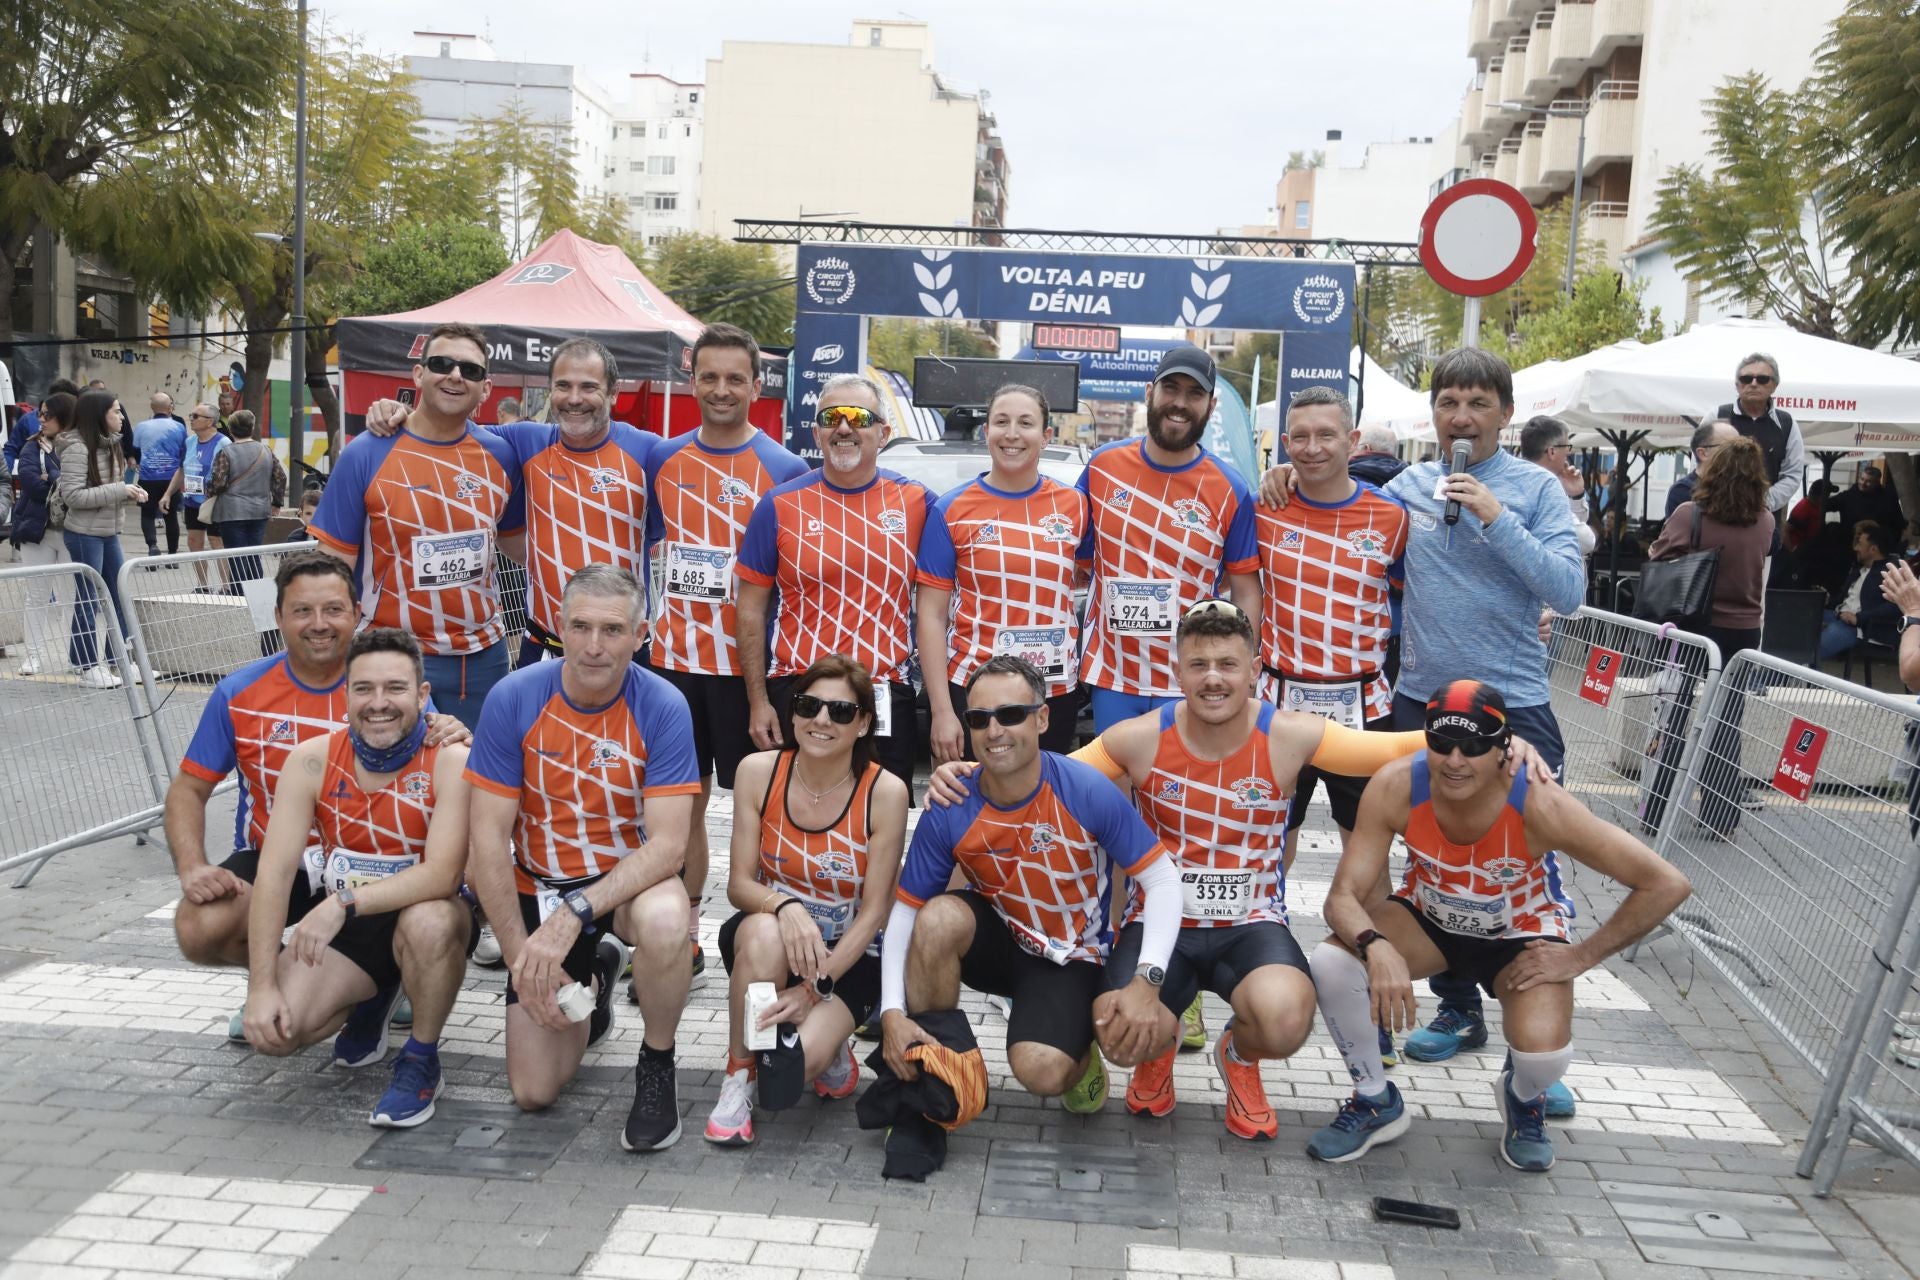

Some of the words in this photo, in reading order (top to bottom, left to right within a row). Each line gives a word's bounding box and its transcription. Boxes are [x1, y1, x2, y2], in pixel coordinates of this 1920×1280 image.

[1001, 266, 1073, 286] VOLTA
[1076, 270, 1094, 287] A
[1098, 271, 1145, 289] PEU
[1029, 288, 1112, 315] DÉNIA
[1291, 368, 1343, 379] BALEARIA
[1818, 399, 1857, 411] DAMM
[424, 563, 432, 574] C
[441, 558, 466, 573] 462
[437, 572, 471, 583] BALEARIA
[672, 569, 678, 580] B
[684, 570, 705, 585] 685
[680, 584, 710, 595] BALEARIA
[1111, 605, 1116, 617] S
[1123, 606, 1149, 620] 974
[1119, 621, 1155, 629] BALEARIA
[1433, 716, 1478, 732] BIKERS
[1232, 779, 1244, 788] Club
[337, 879, 345, 890] B
[1224, 875, 1250, 883] ESPORT
[1197, 885, 1238, 900] 3525
[1204, 907, 1232, 915] DÉNIA
[1448, 912, 1481, 927] 875
